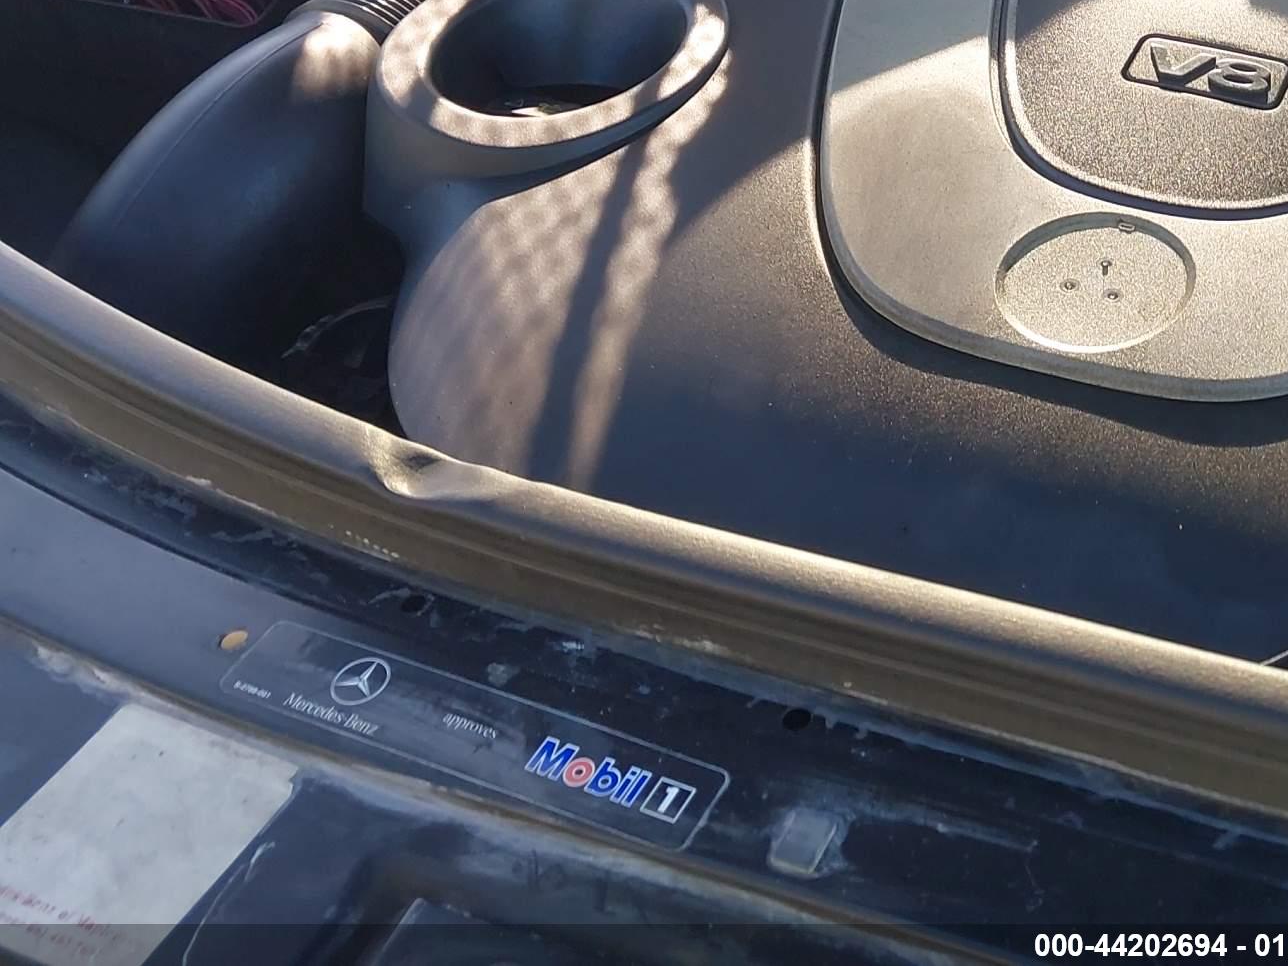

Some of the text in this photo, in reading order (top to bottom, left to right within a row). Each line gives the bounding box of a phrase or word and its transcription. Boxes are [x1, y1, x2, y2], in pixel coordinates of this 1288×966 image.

[1149, 44, 1271, 101] V8
[282, 692, 379, 735] Mercedes-Benz
[442, 713, 497, 739] approves
[524, 736, 652, 808] Mobil
